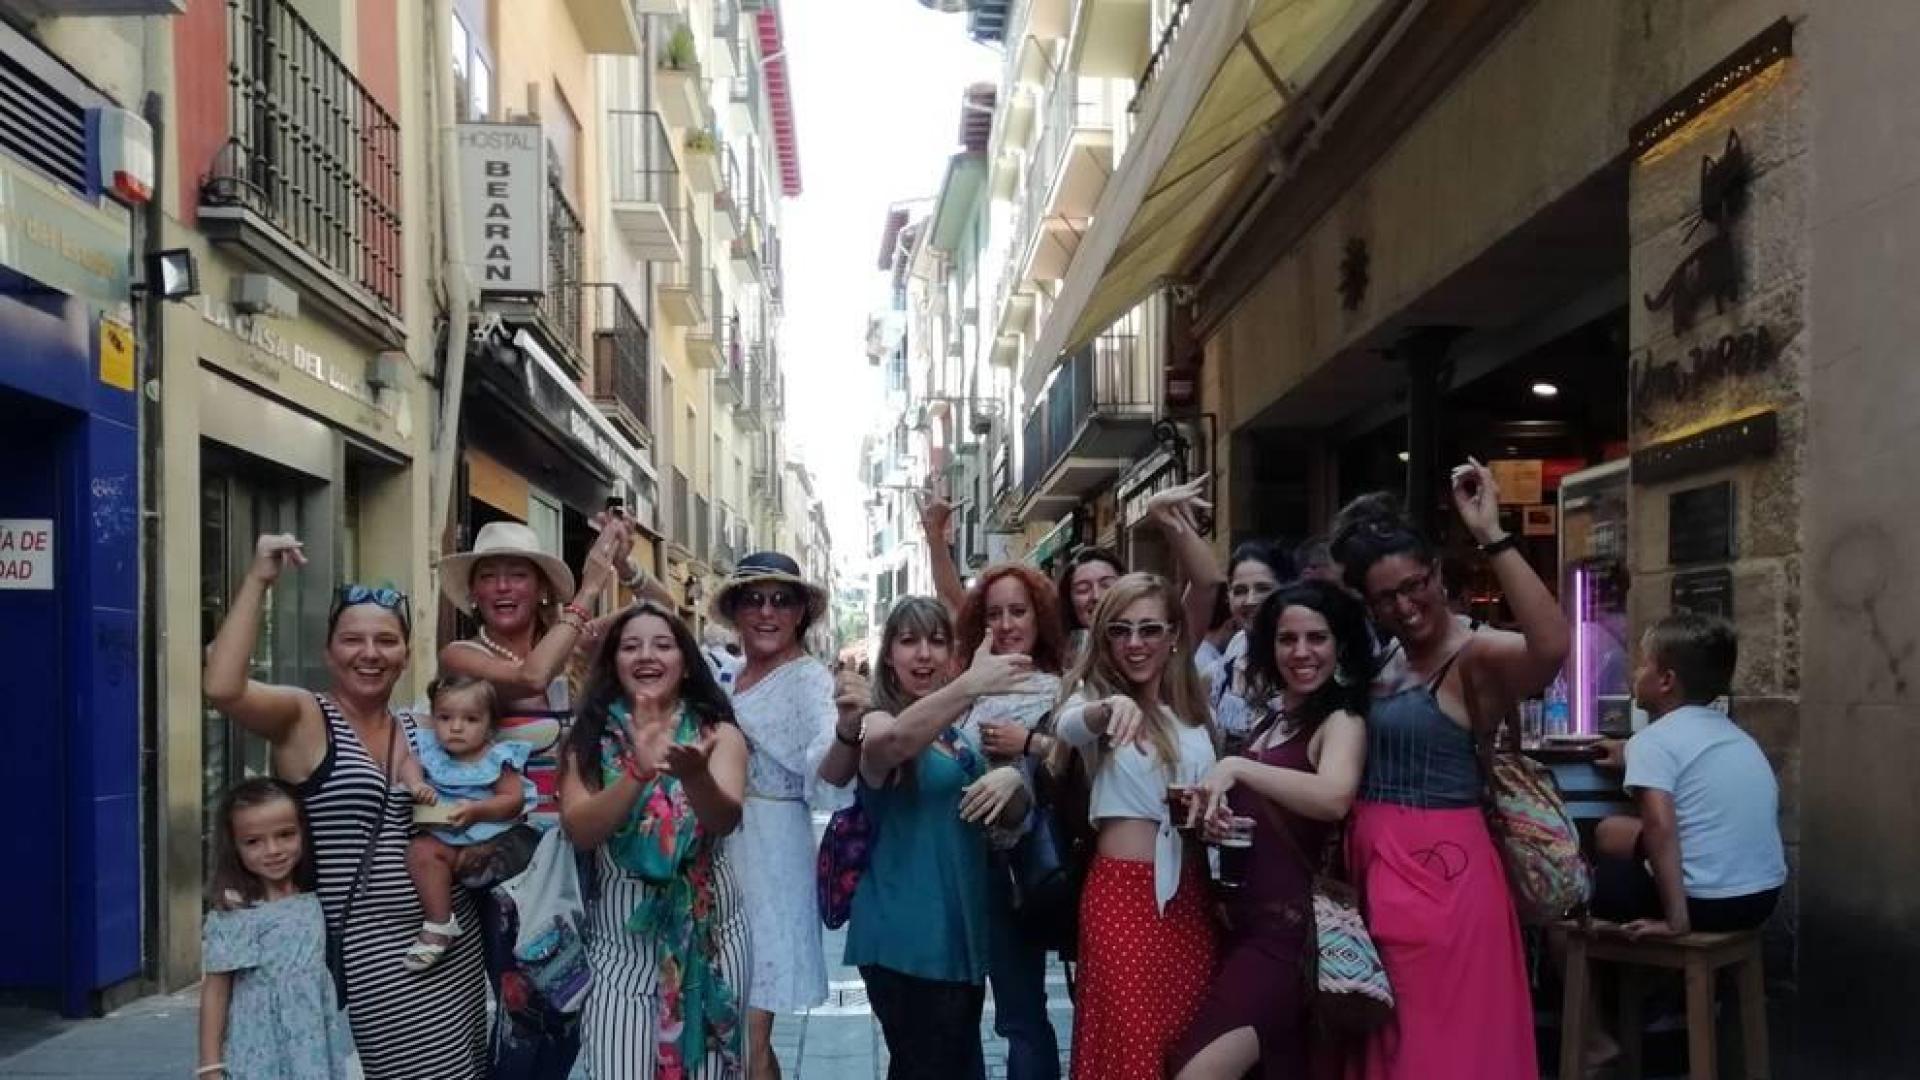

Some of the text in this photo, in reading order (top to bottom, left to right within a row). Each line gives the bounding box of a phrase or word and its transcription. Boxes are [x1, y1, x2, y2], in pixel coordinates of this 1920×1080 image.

[459, 131, 533, 150] HOSTAL
[485, 160, 511, 281] BEARAN
[294, 343, 325, 382] DEL
[21, 530, 47, 551] DE
